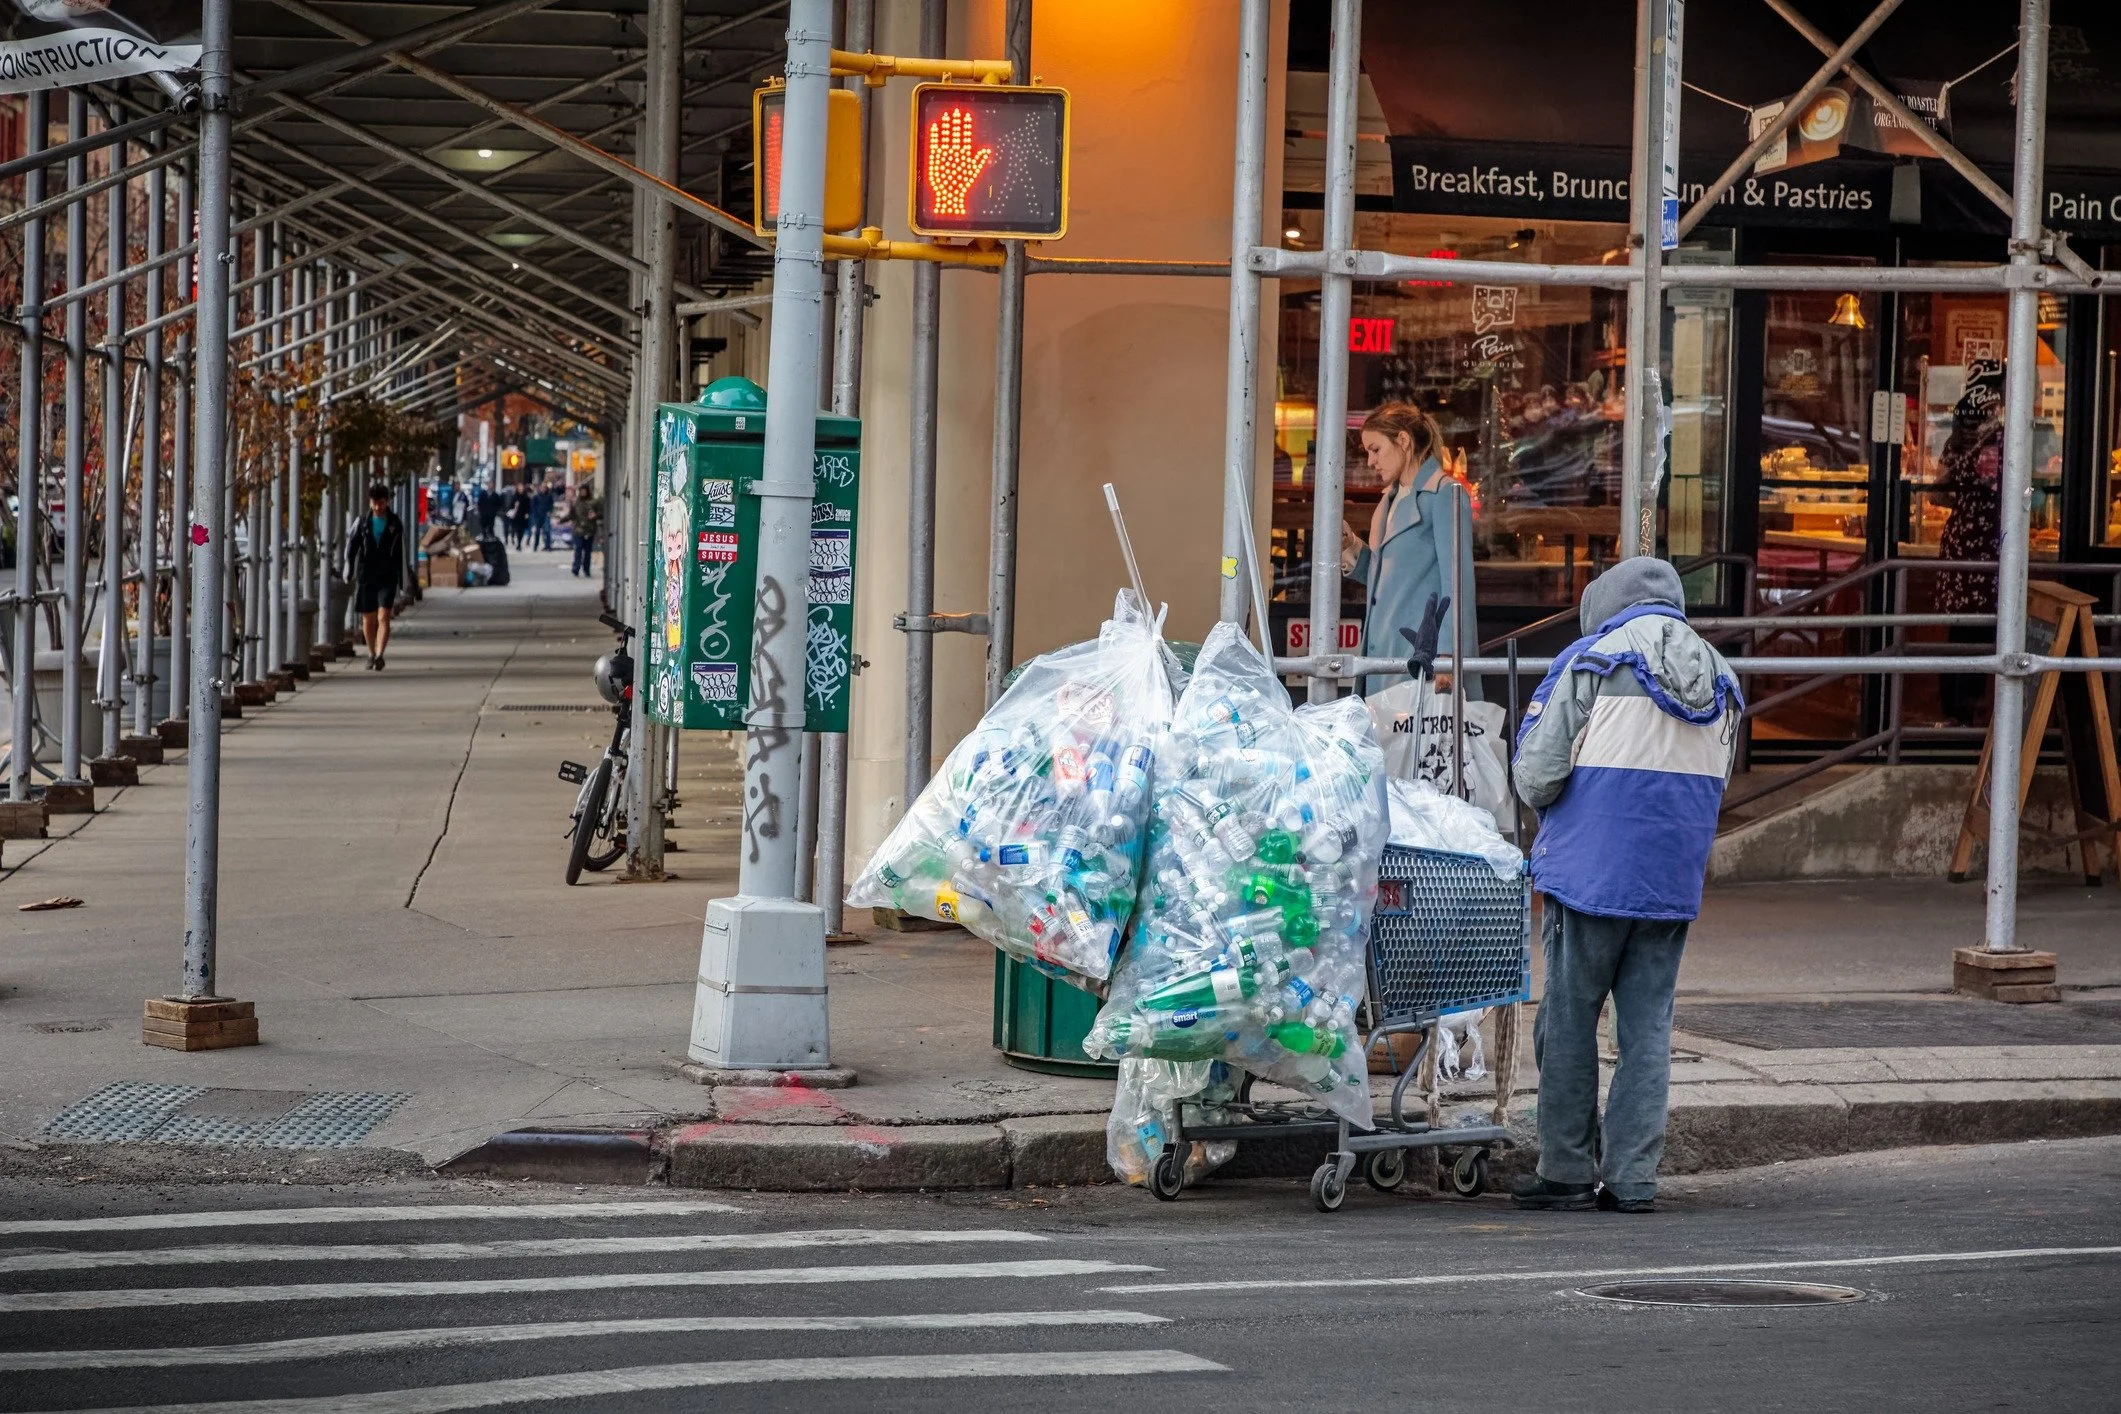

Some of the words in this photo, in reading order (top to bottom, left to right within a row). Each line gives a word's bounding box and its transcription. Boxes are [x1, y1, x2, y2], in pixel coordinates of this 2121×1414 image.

[1412, 164, 1545, 202] Breakfast,
[1552, 171, 1628, 200] Brunc
[1743, 178, 1765, 207] &
[1774, 181, 1873, 210] Pastries
[2049, 192, 2102, 220] Pain
[1349, 318, 1395, 354] EXIT
[1472, 335, 1515, 359] Pain
[702, 533, 734, 543] JESUS
[701, 551, 733, 560] SAVES
[1173, 1012, 1198, 1022] smart
